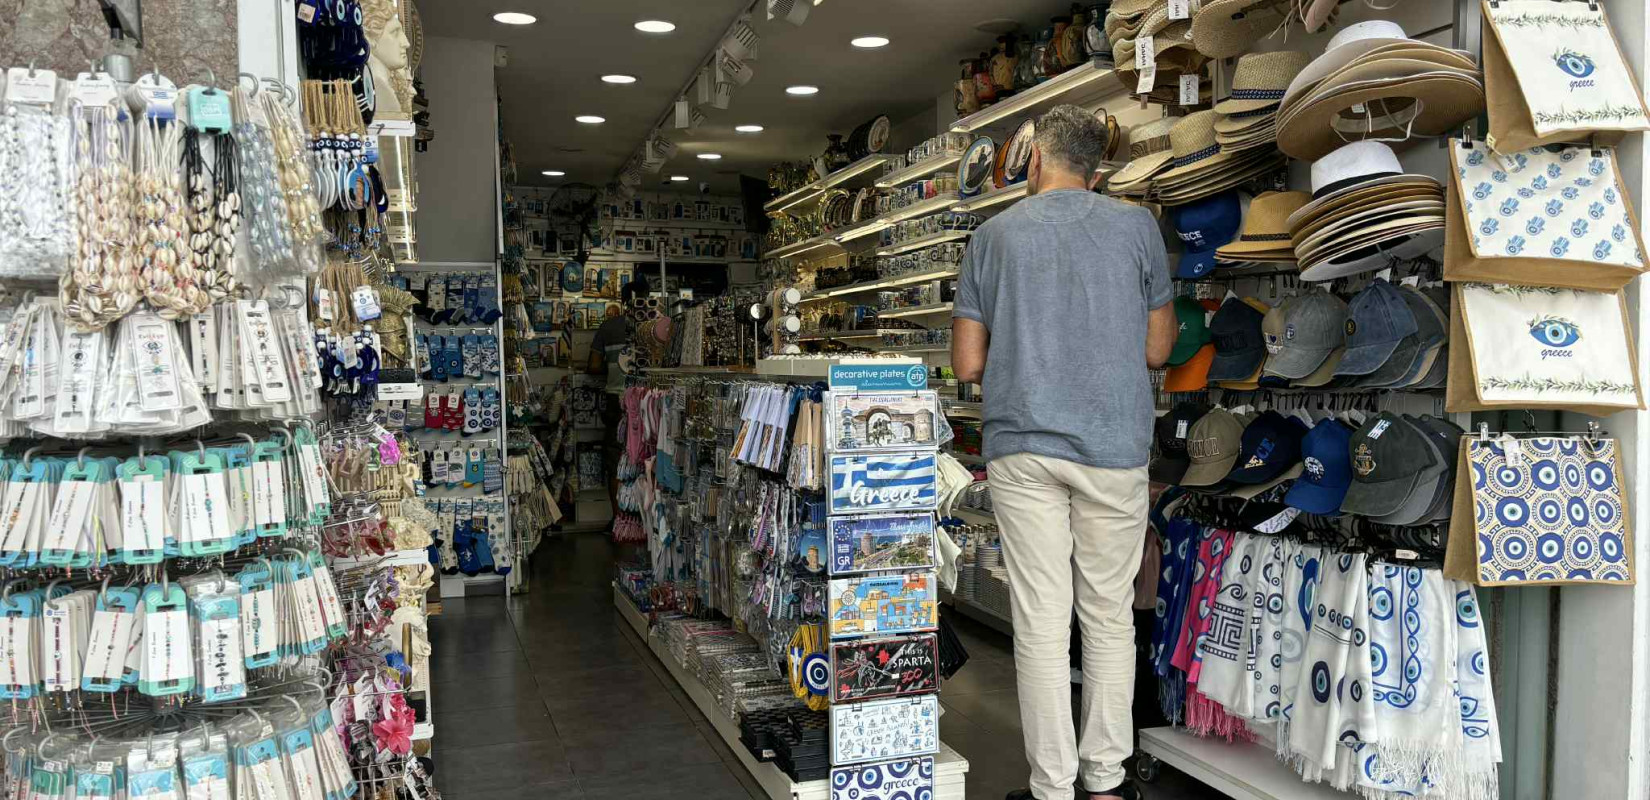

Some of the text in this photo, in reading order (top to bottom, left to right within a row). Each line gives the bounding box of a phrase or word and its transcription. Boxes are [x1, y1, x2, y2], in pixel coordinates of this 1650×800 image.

[1540, 348, 1573, 360] greece
[834, 370, 906, 381] decorative plates
[850, 480, 920, 506] Greece
[837, 556, 851, 566] GR
[892, 656, 932, 668] SPARTA
[883, 778, 920, 795] greece
